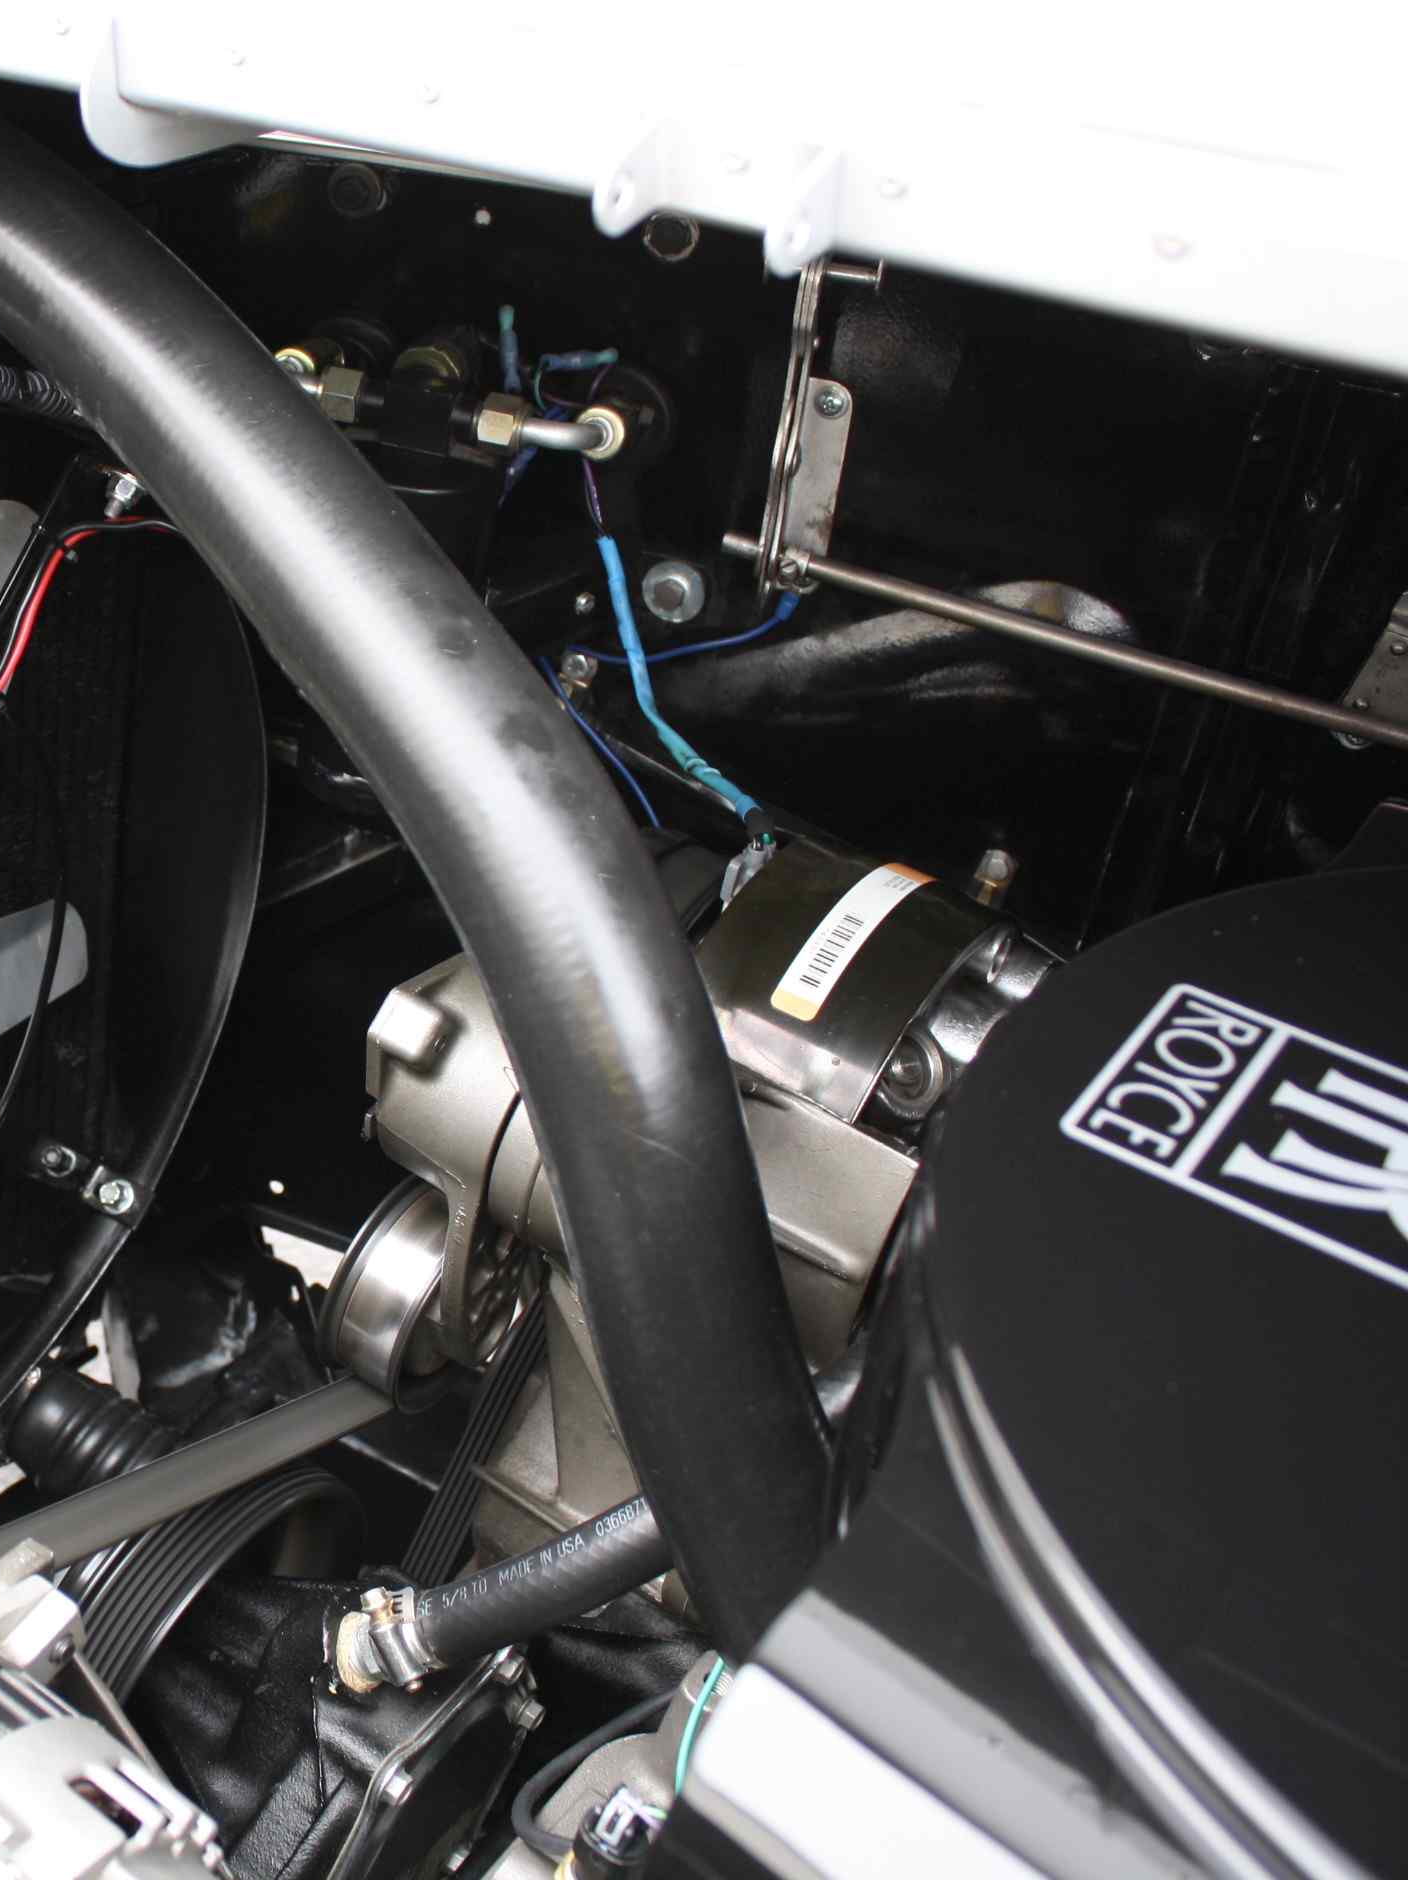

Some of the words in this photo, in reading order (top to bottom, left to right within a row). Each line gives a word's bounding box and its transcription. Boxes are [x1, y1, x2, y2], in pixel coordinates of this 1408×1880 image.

[1087, 998, 1263, 1160] ROYCE
[497, 1555, 536, 1587] MADE
[539, 1548, 553, 1570] IN
[556, 1532, 586, 1559] USA
